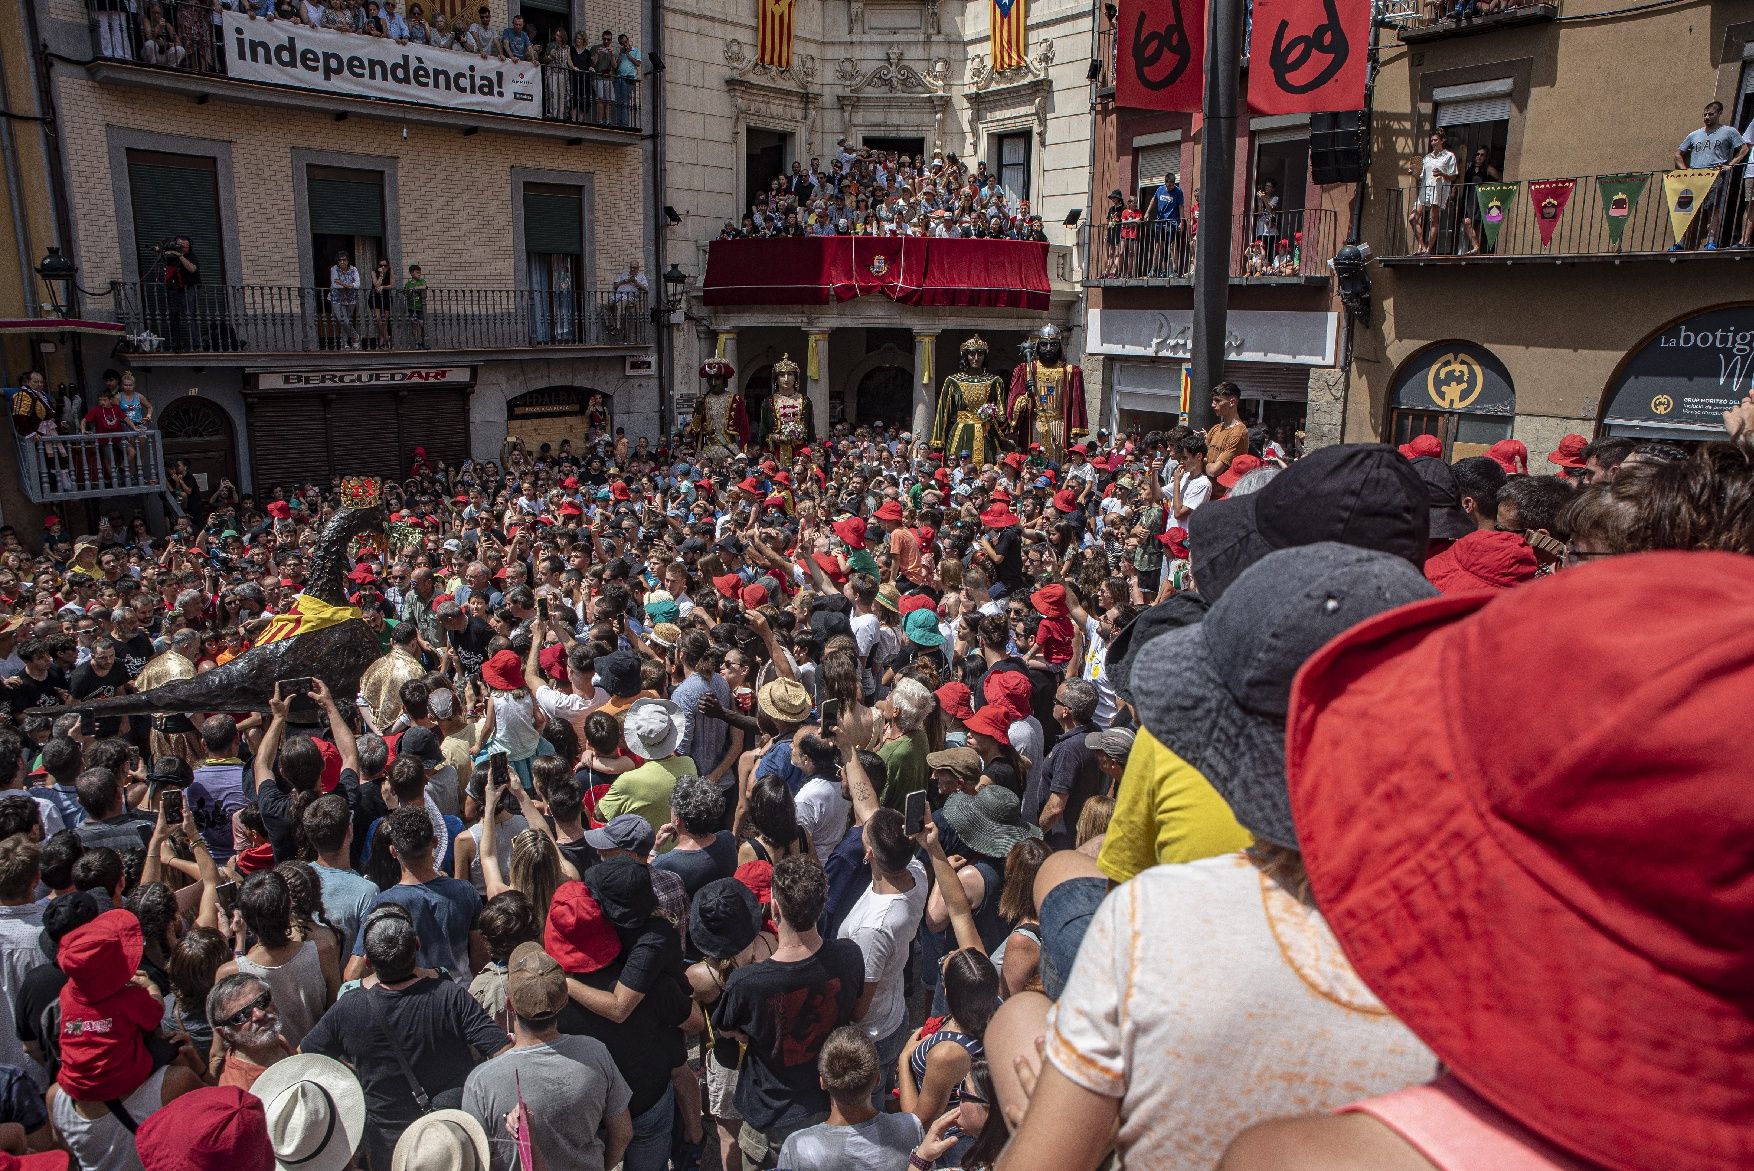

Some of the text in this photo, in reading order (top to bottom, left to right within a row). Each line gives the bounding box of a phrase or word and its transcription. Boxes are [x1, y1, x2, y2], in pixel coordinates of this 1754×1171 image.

[234, 26, 506, 98] independència!
[1660, 325, 1754, 355] La botig
[281, 369, 453, 386] BERGUEDART
